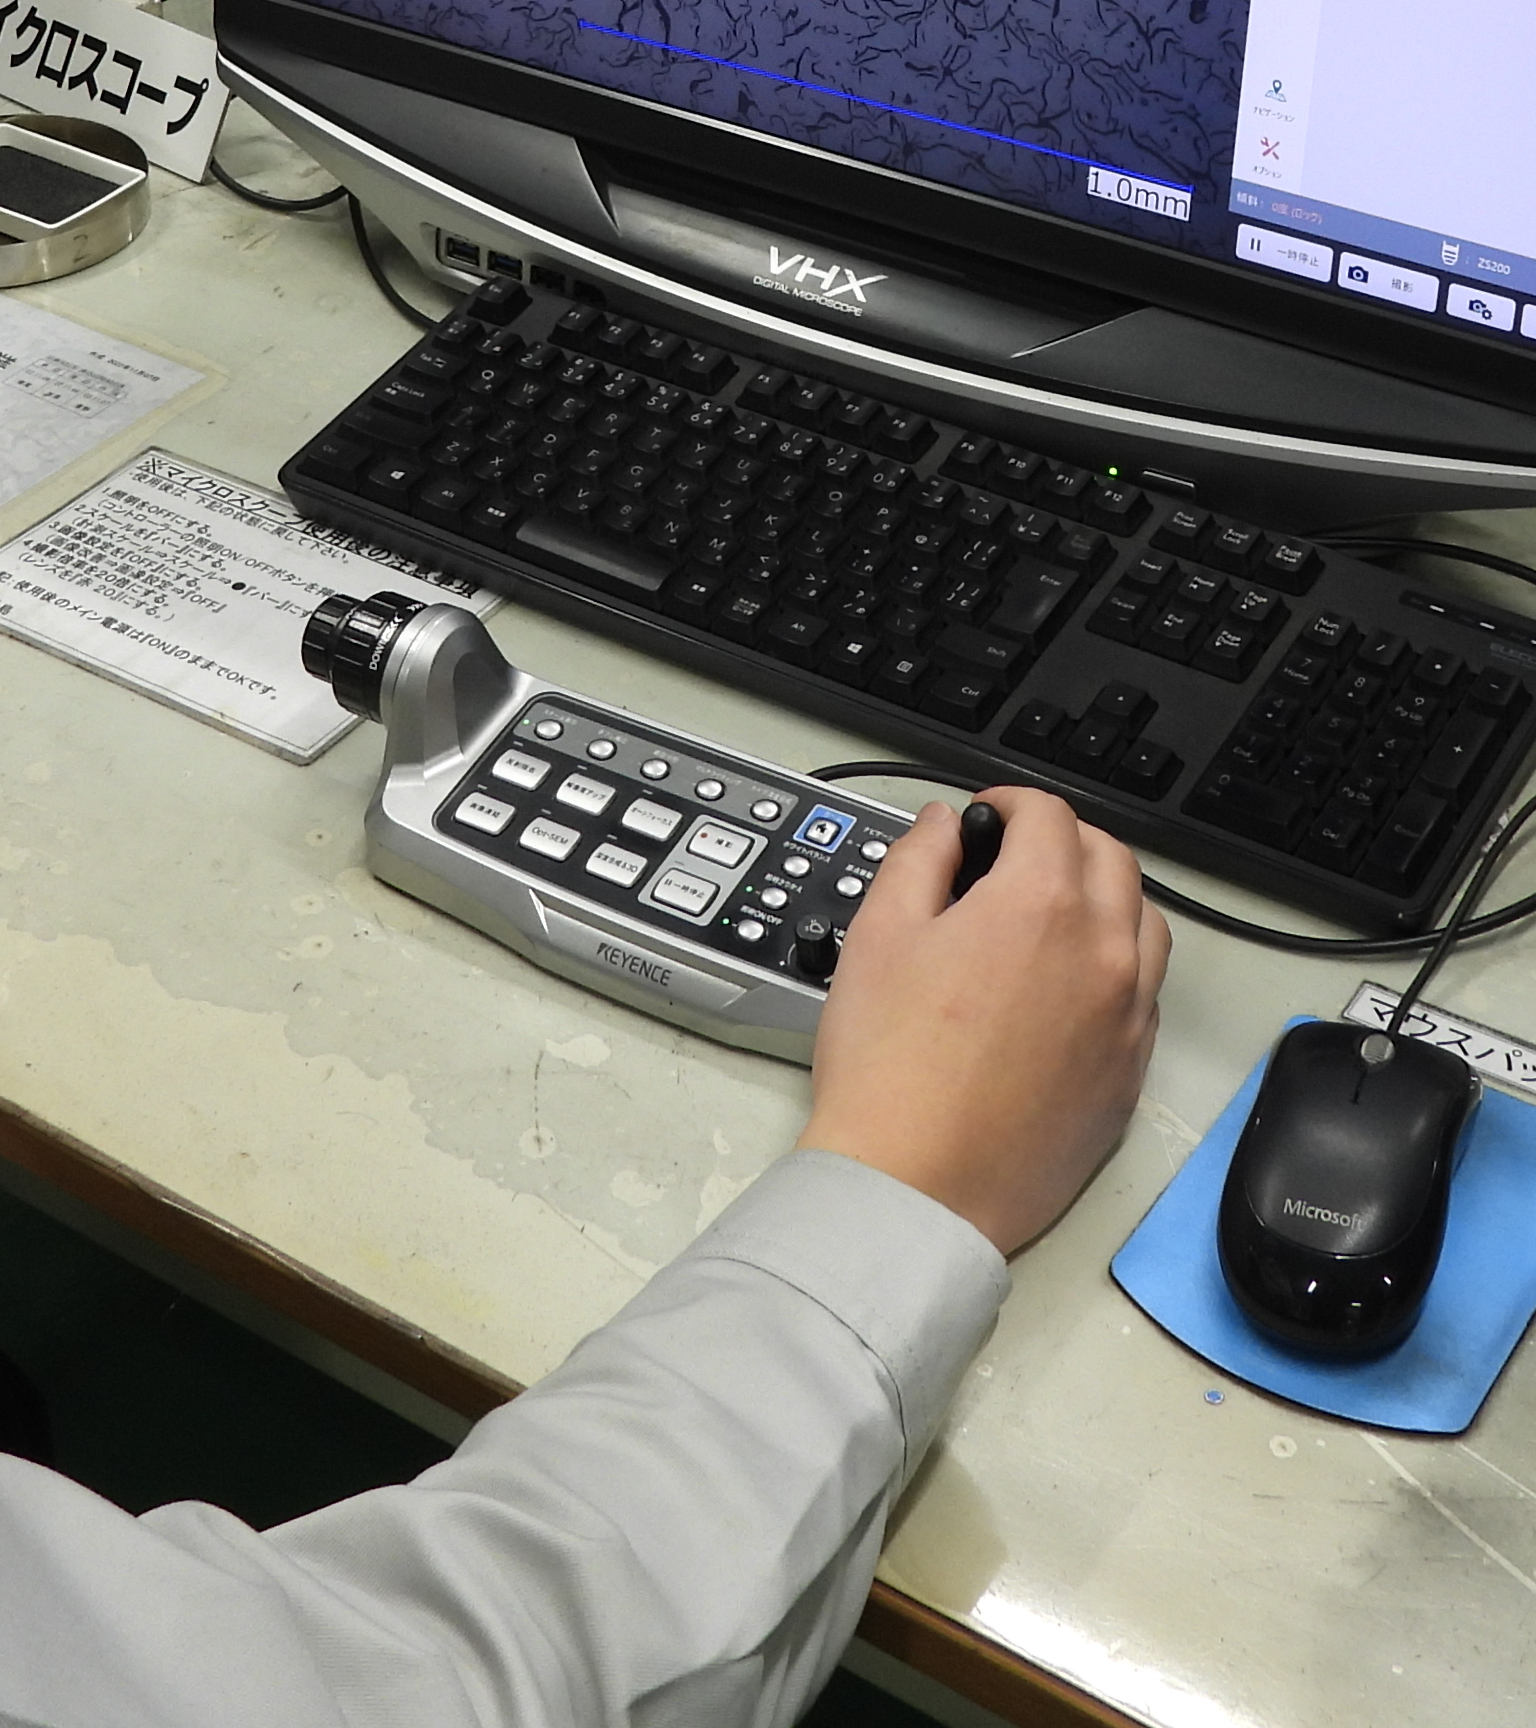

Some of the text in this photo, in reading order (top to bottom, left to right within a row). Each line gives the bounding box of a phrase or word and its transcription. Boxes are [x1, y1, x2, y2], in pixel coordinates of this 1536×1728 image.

[1089, 170, 1189, 219] 1.0mm
[1276, 247, 1320, 268] 一時停止
[769, 245, 889, 303] VHX
[753, 275, 863, 317] DIGITAL MICROSCOPE
[1008, 458, 1026, 469] F10
[1056, 474, 1074, 485] F11
[1105, 490, 1123, 502] F12
[1039, 574, 1062, 586] Enter
[596, 942, 673, 988] KEYENCE
[1283, 1196, 1366, 1232] Microsoft
